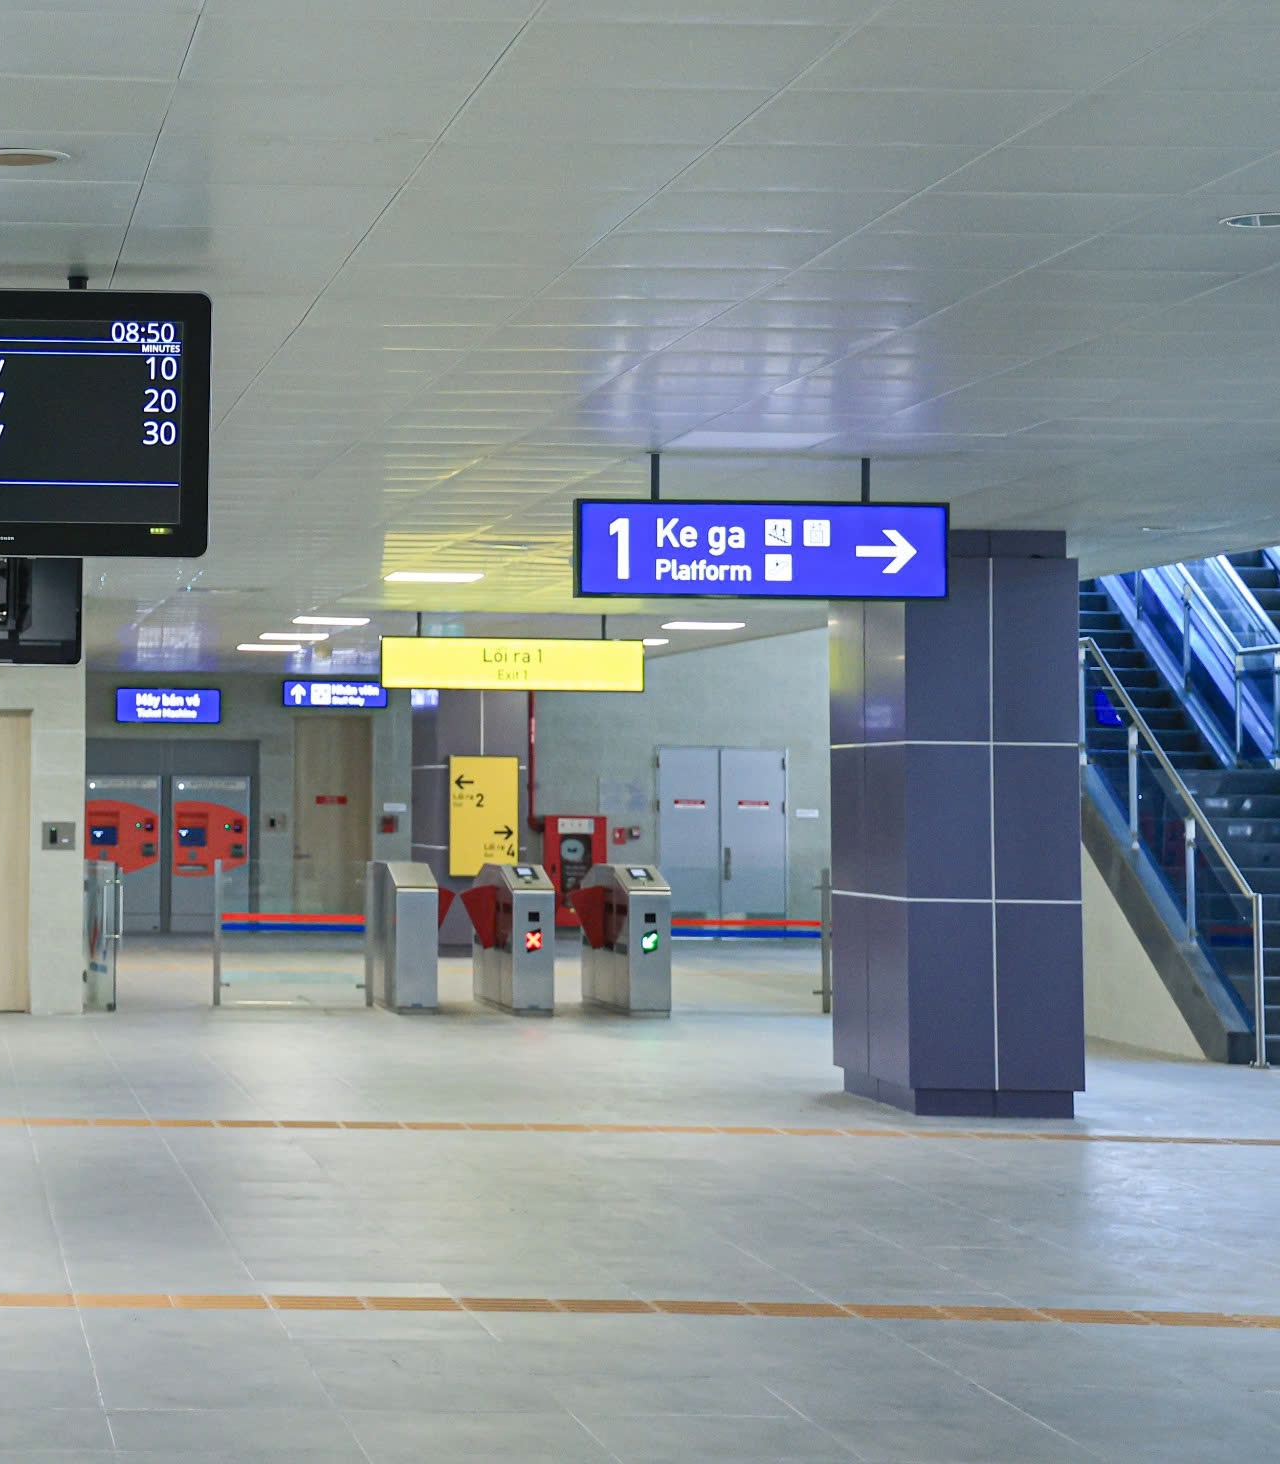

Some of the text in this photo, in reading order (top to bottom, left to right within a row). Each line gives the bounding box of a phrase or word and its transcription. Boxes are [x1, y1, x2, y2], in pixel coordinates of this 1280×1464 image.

[111, 322, 175, 343] 08:50
[141, 344, 181, 353] MINUTES
[145, 356, 177, 381] 10
[143, 388, 177, 413] 20
[142, 421, 176, 446] 30
[656, 517, 746, 556] Ke ga
[609, 517, 630, 580] 1
[655, 558, 752, 582] Platform
[514, 652, 530, 663] ra
[538, 648, 543, 664] 1
[498, 669, 519, 680] Exit
[475, 793, 484, 808] 2
[506, 844, 515, 857] 4
